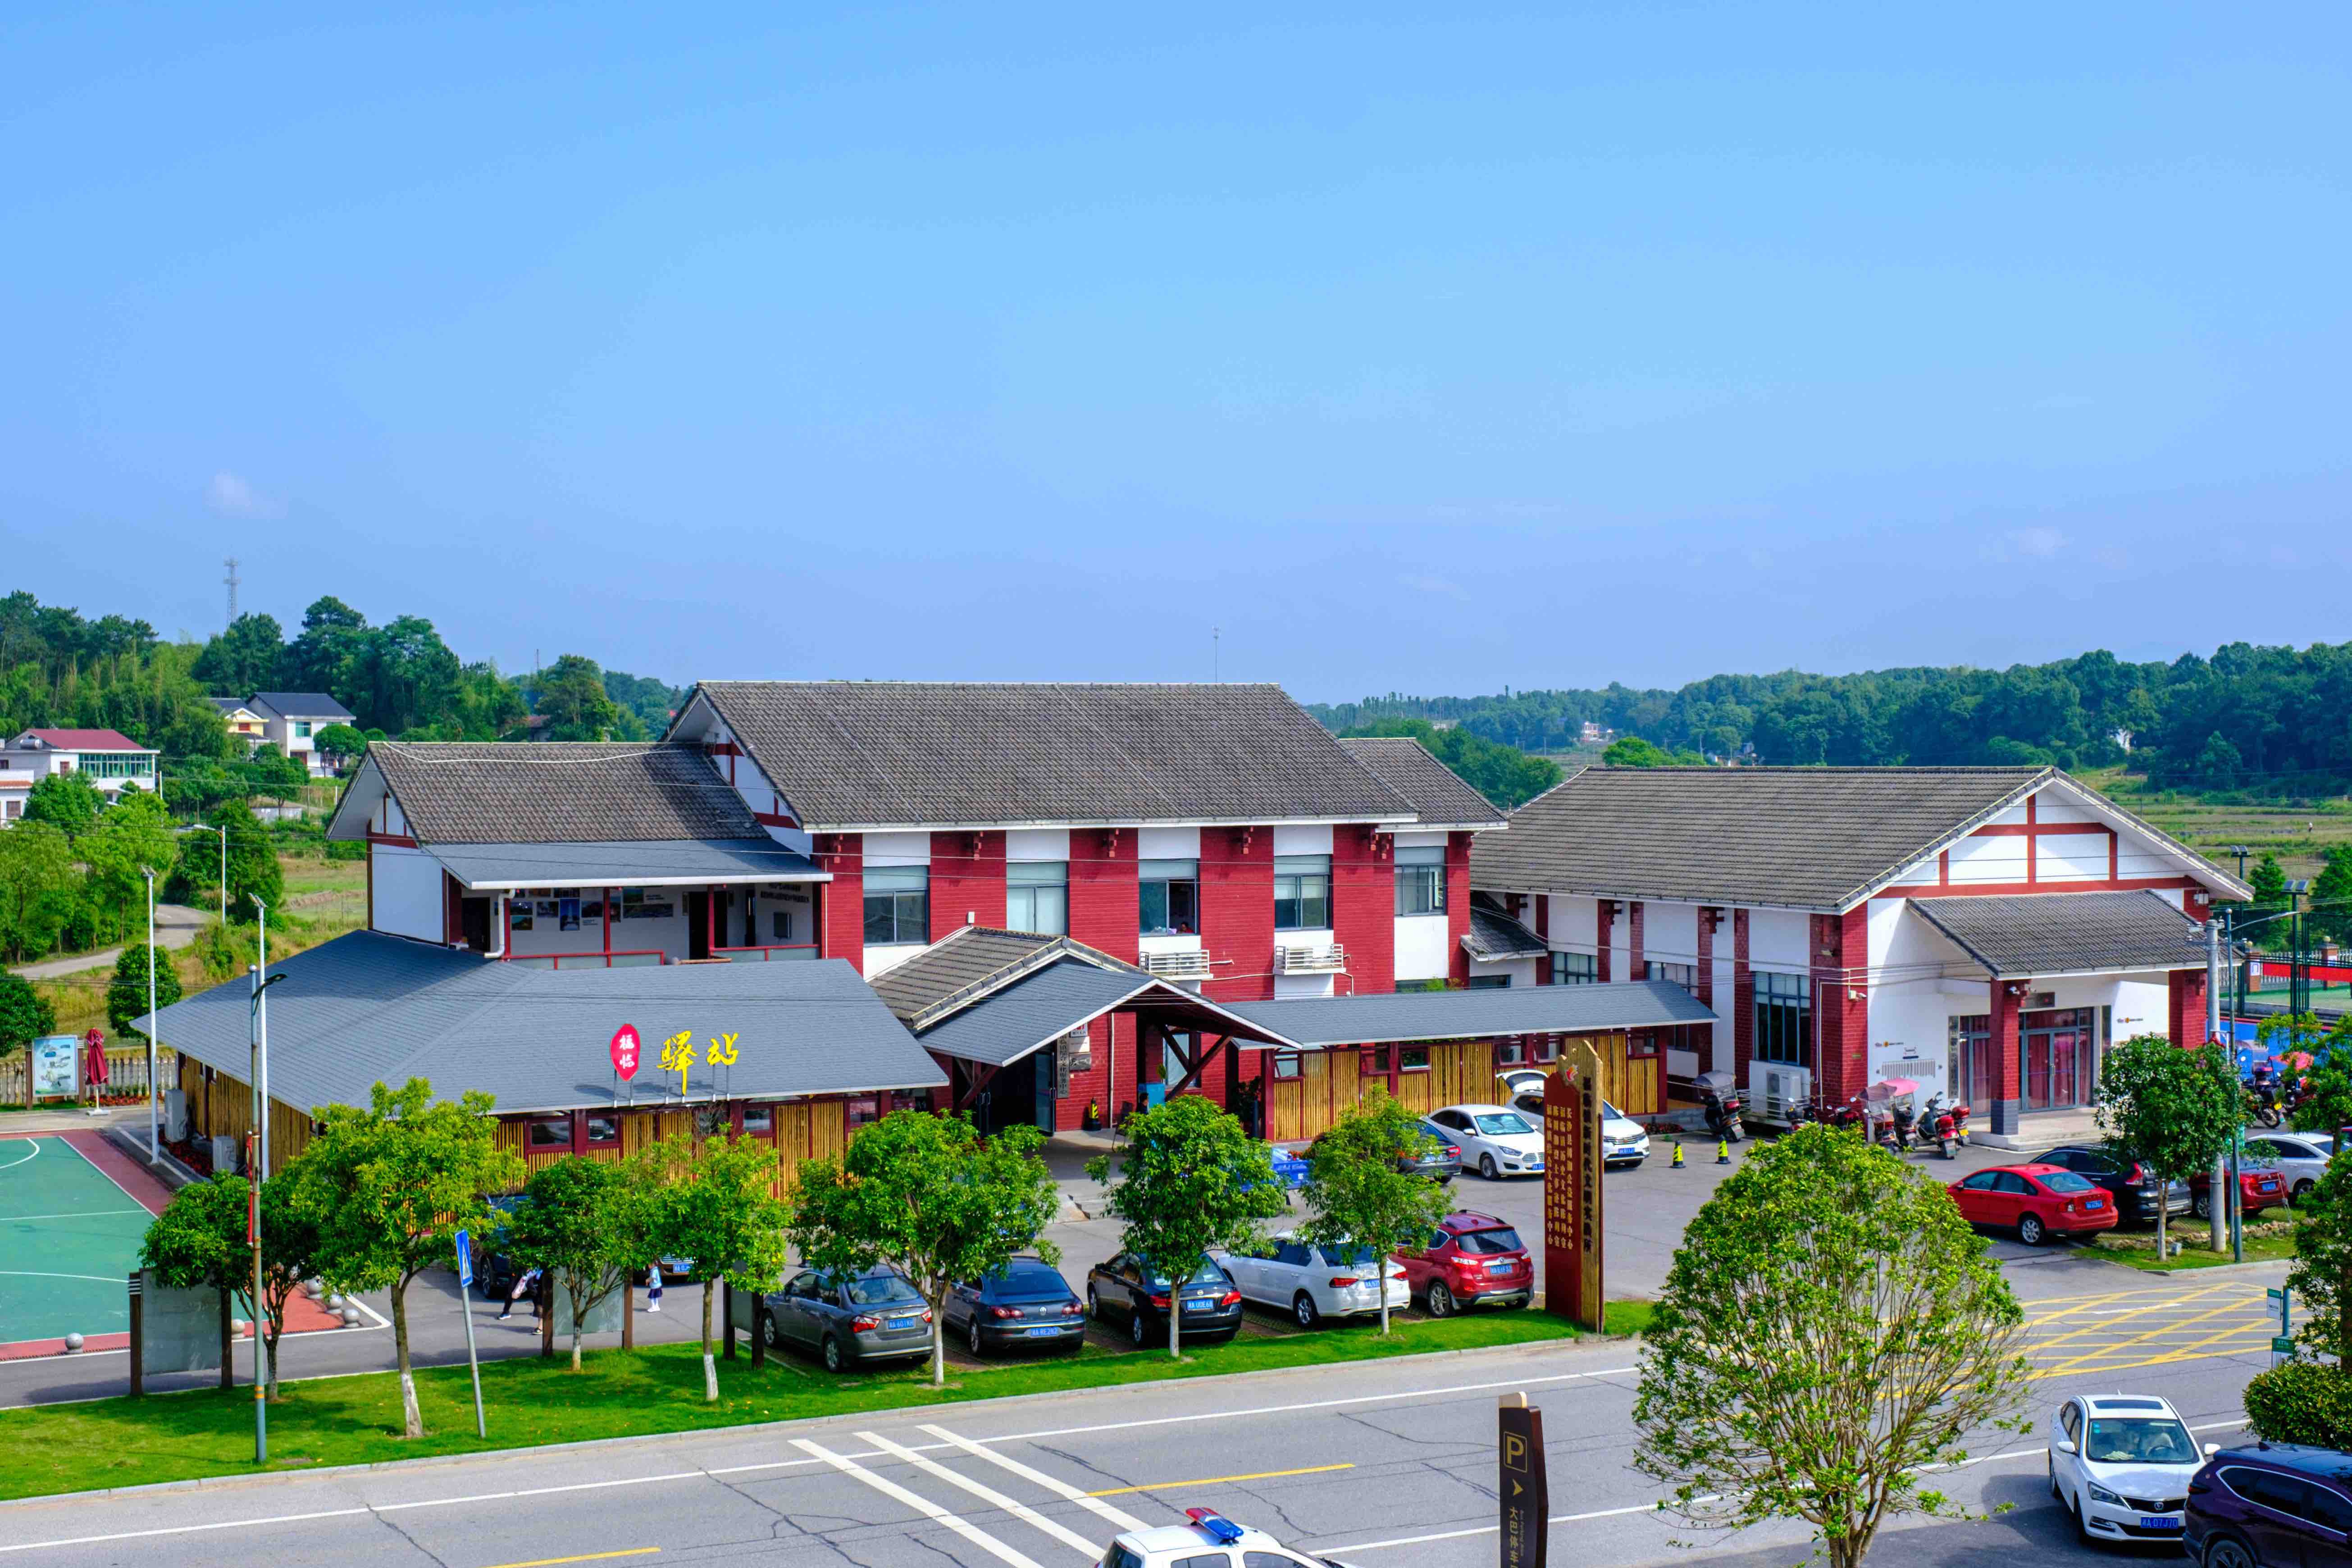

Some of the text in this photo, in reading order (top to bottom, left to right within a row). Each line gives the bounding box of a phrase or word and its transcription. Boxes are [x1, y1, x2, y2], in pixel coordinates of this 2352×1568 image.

[619, 1034, 635, 1069] 福临
[1506, 1436, 1525, 1465] P
[1509, 1506, 1519, 1568] 大巴停车
